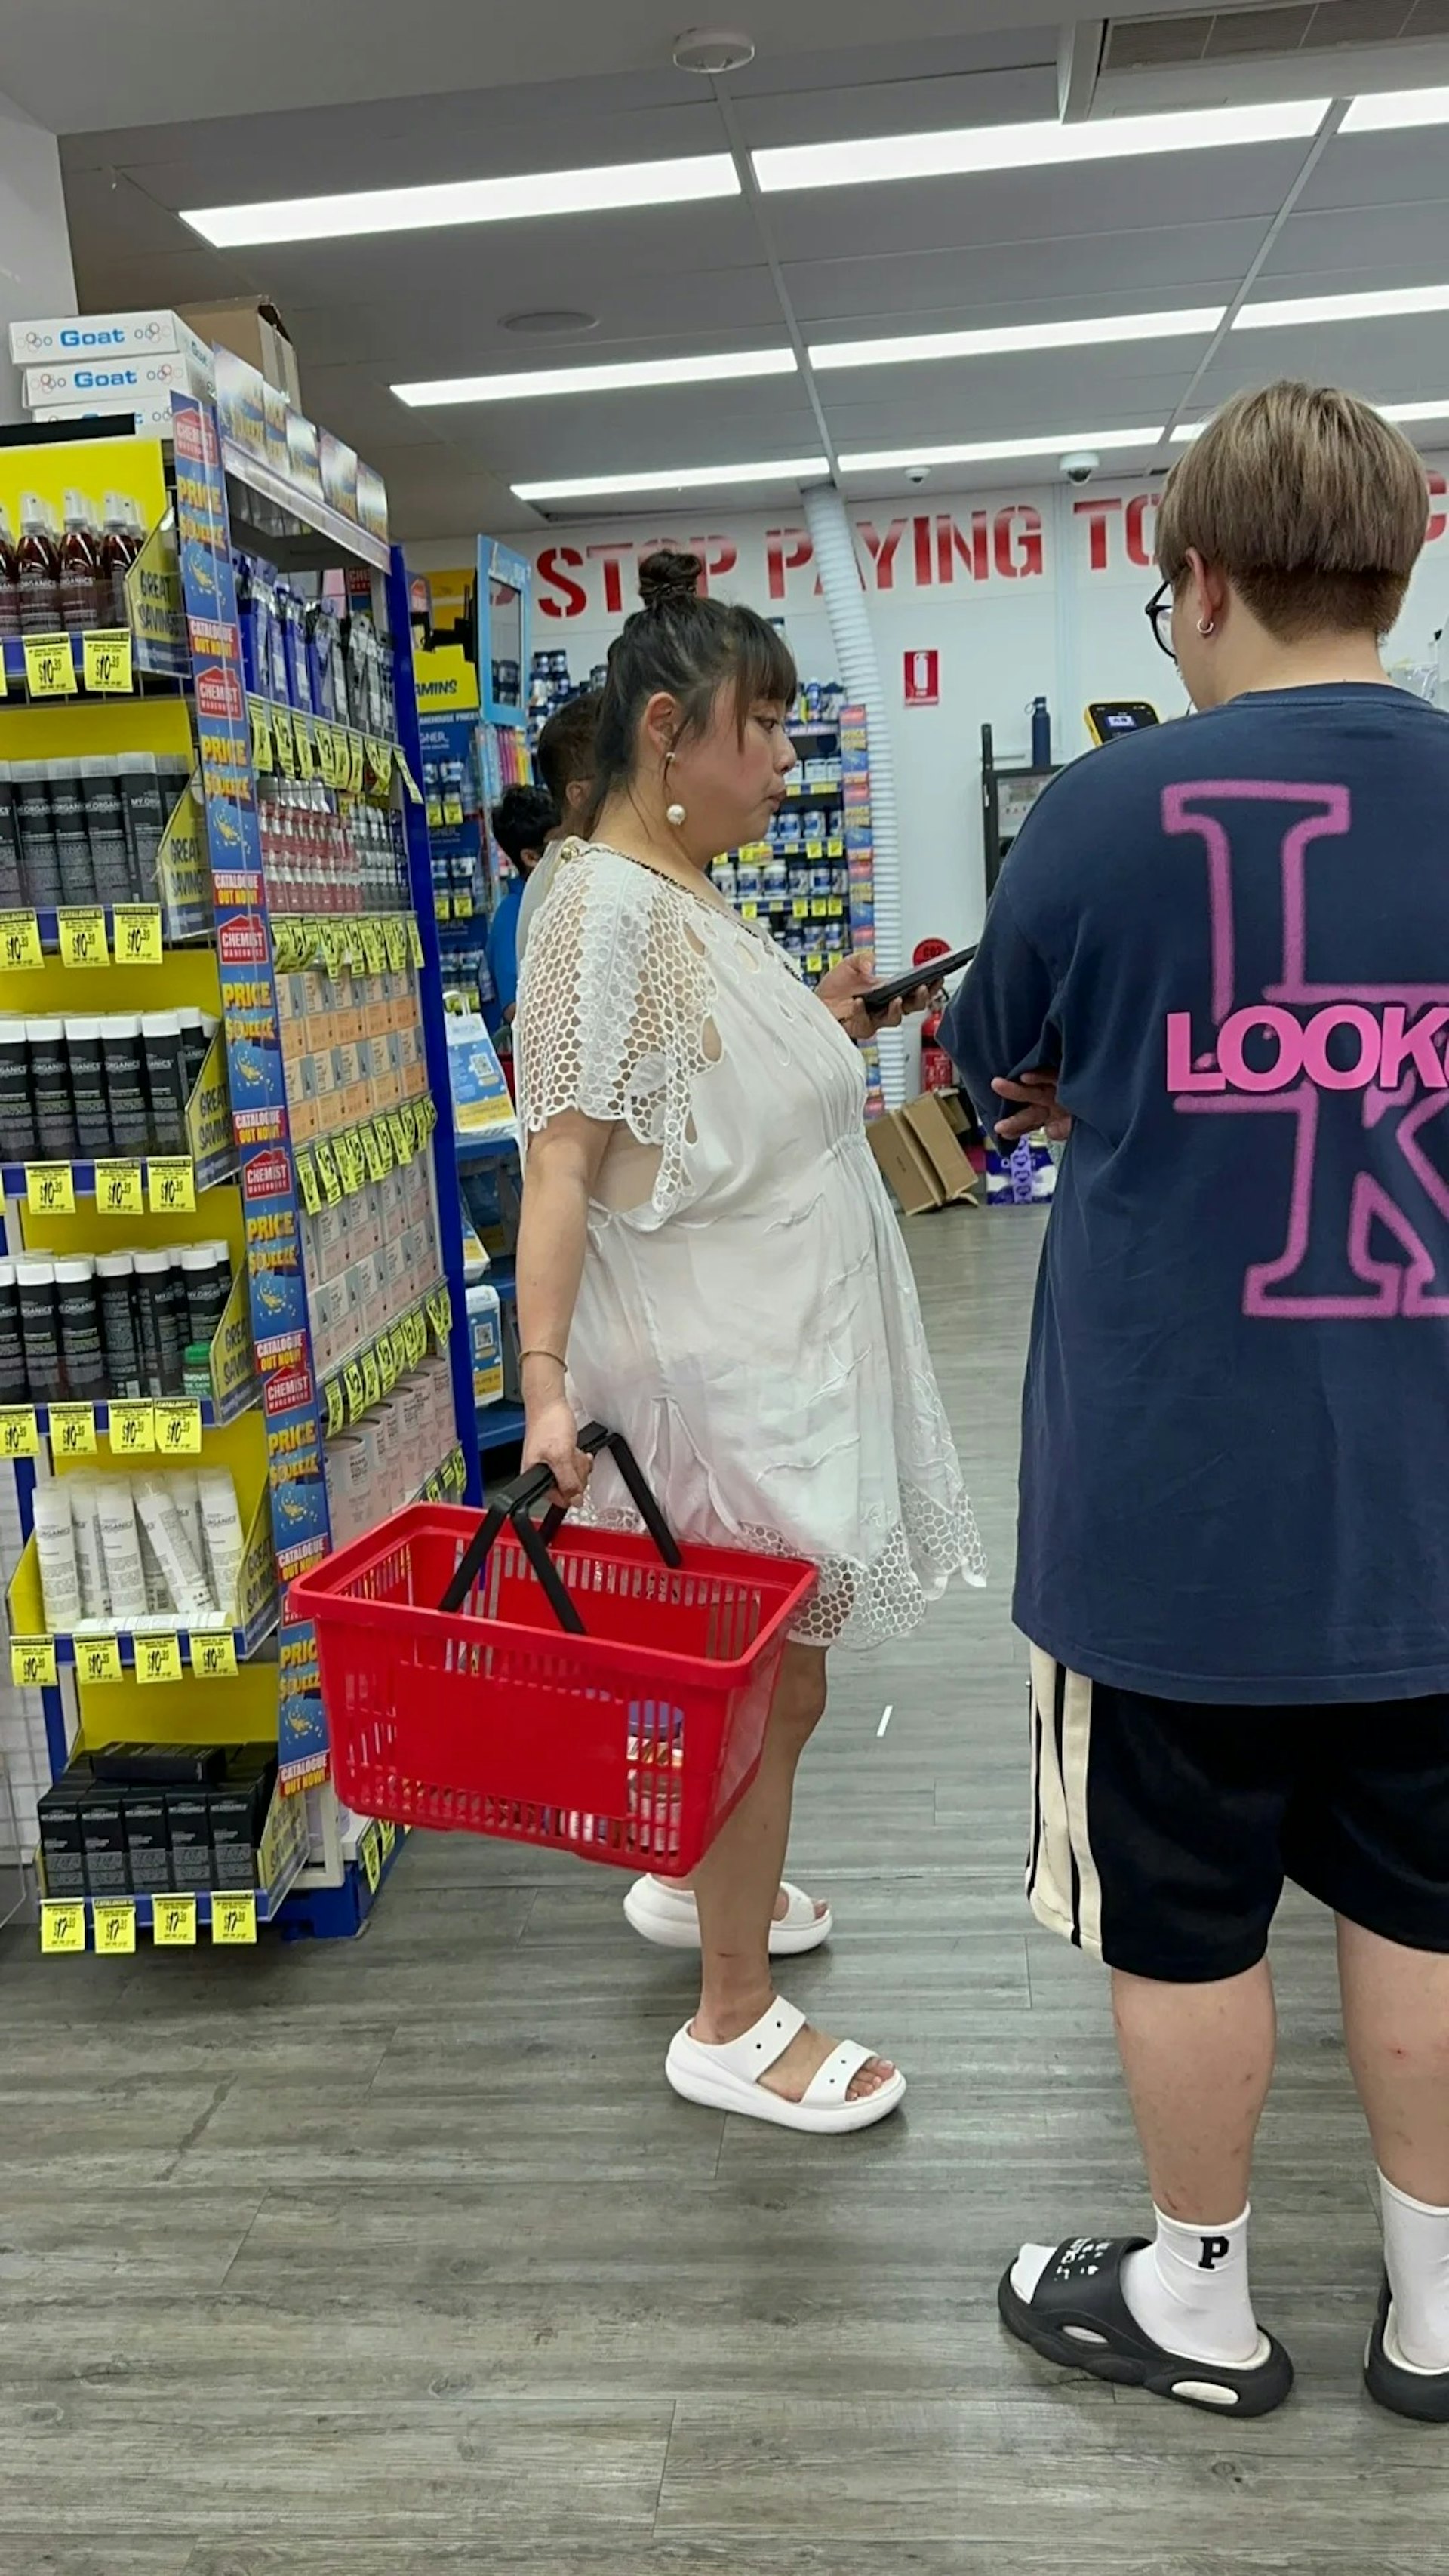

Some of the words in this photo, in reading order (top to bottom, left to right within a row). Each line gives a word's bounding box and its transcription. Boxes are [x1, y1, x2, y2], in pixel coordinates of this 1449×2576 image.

[60, 329, 125, 346] Goat
[74, 370, 137, 388] Goat
[537, 535, 737, 618] STP
[766, 505, 1043, 599] PYING
[214, 874, 258, 889] CATALOGUE
[218, 889, 234, 905] OUT
[222, 932, 263, 948] CHEMIST
[223, 982, 272, 1008] PRICE
[1166, 1005, 1449, 1092] LOOK
[235, 1110, 280, 1129] CATALOGUE
[239, 1127, 256, 1143] OUT
[248, 1164, 286, 1184] CHEMIST
[247, 1211, 295, 1244] PRICE
[257, 1333, 303, 1357] CATALOGUE
[260, 1354, 277, 1371] OUT
[267, 1375, 309, 1402] CHEMIST
[269, 1420, 316, 1457] PRICE
[280, 1637, 318, 1670] PRIC
[281, 1753, 326, 1783] CATALOGUE
[284, 1776, 300, 1796] OUT
[1198, 2236, 1229, 2269] P
